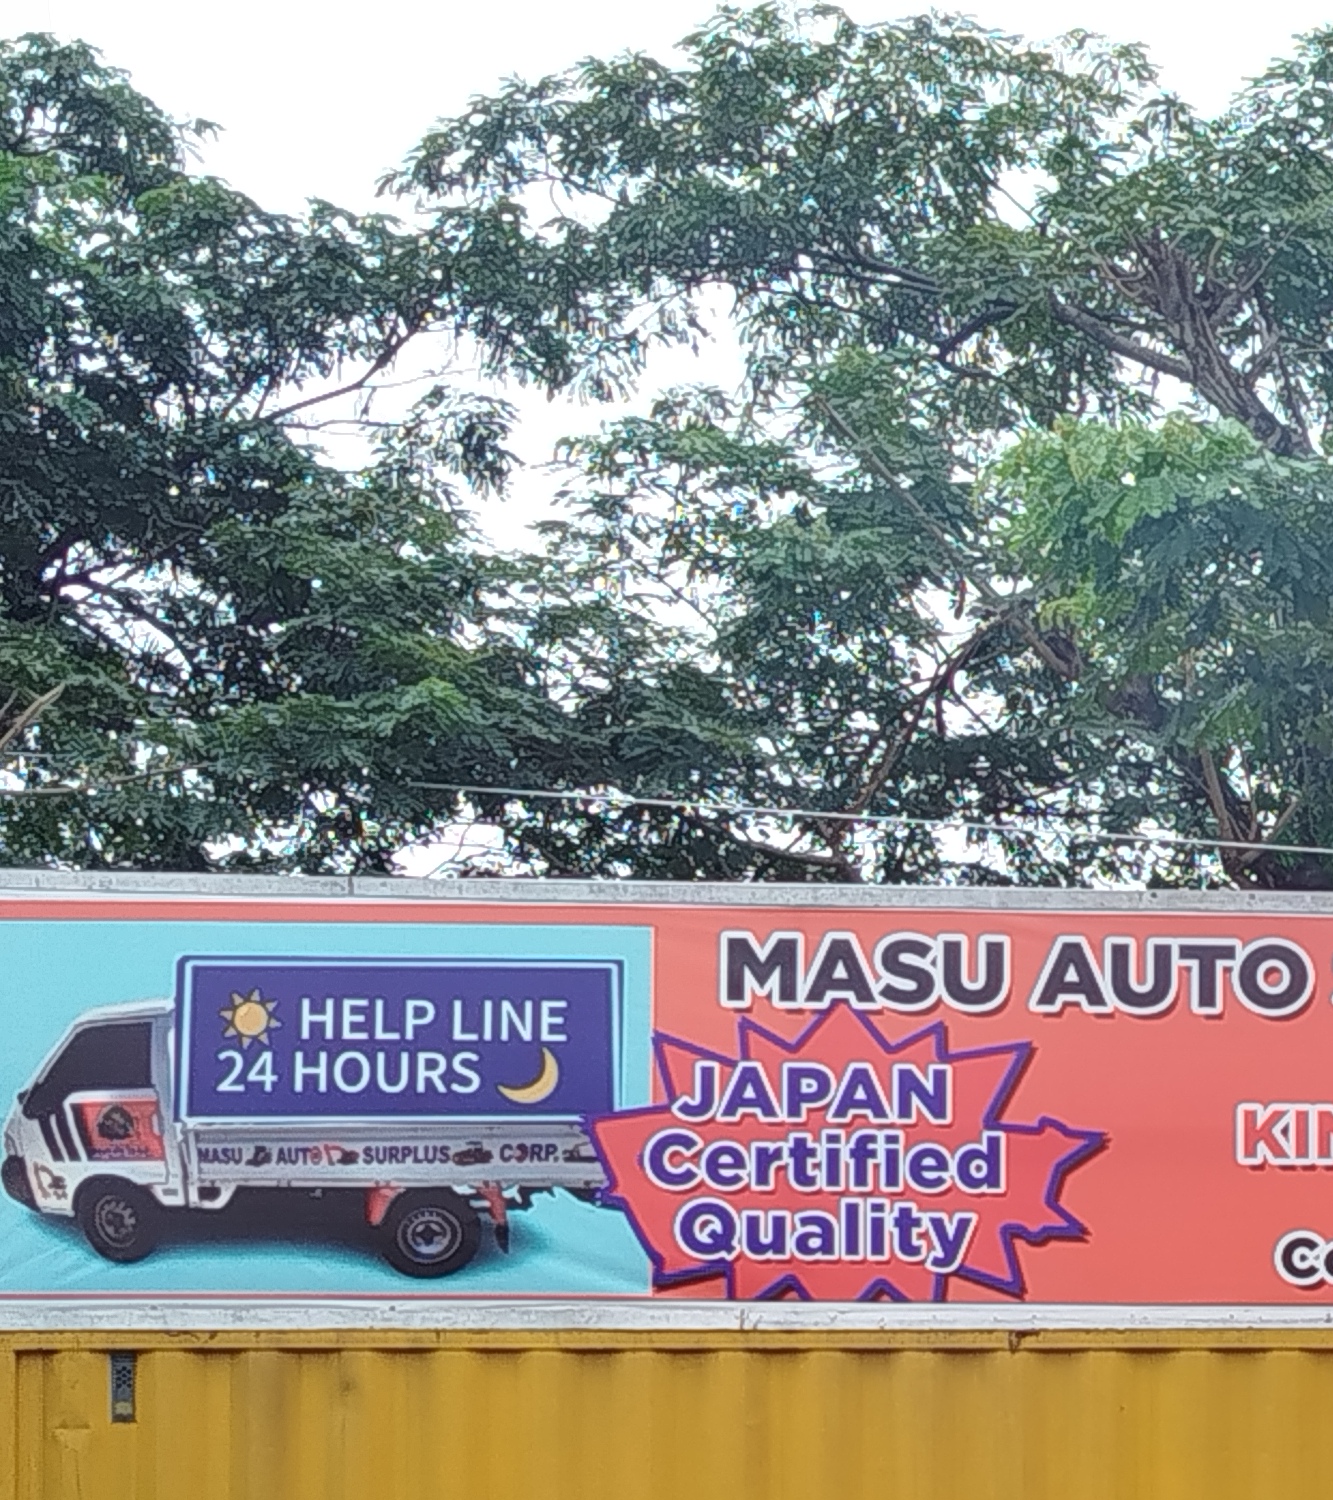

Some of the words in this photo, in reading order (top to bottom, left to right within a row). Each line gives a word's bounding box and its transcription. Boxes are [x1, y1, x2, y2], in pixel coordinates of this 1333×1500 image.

[720, 933, 1006, 1009] MASU
[1036, 935, 1311, 1013] AUTO
[301, 998, 436, 1043] HELP
[452, 999, 568, 1043] LINE
[216, 1051, 278, 1093] 24
[294, 1050, 481, 1094] HOURS
[673, 1062, 950, 1123] JAPAN
[361, 1145, 451, 1165] SURPLUS
[646, 1129, 1004, 1193] Certified
[676, 1199, 976, 1272] Quality
